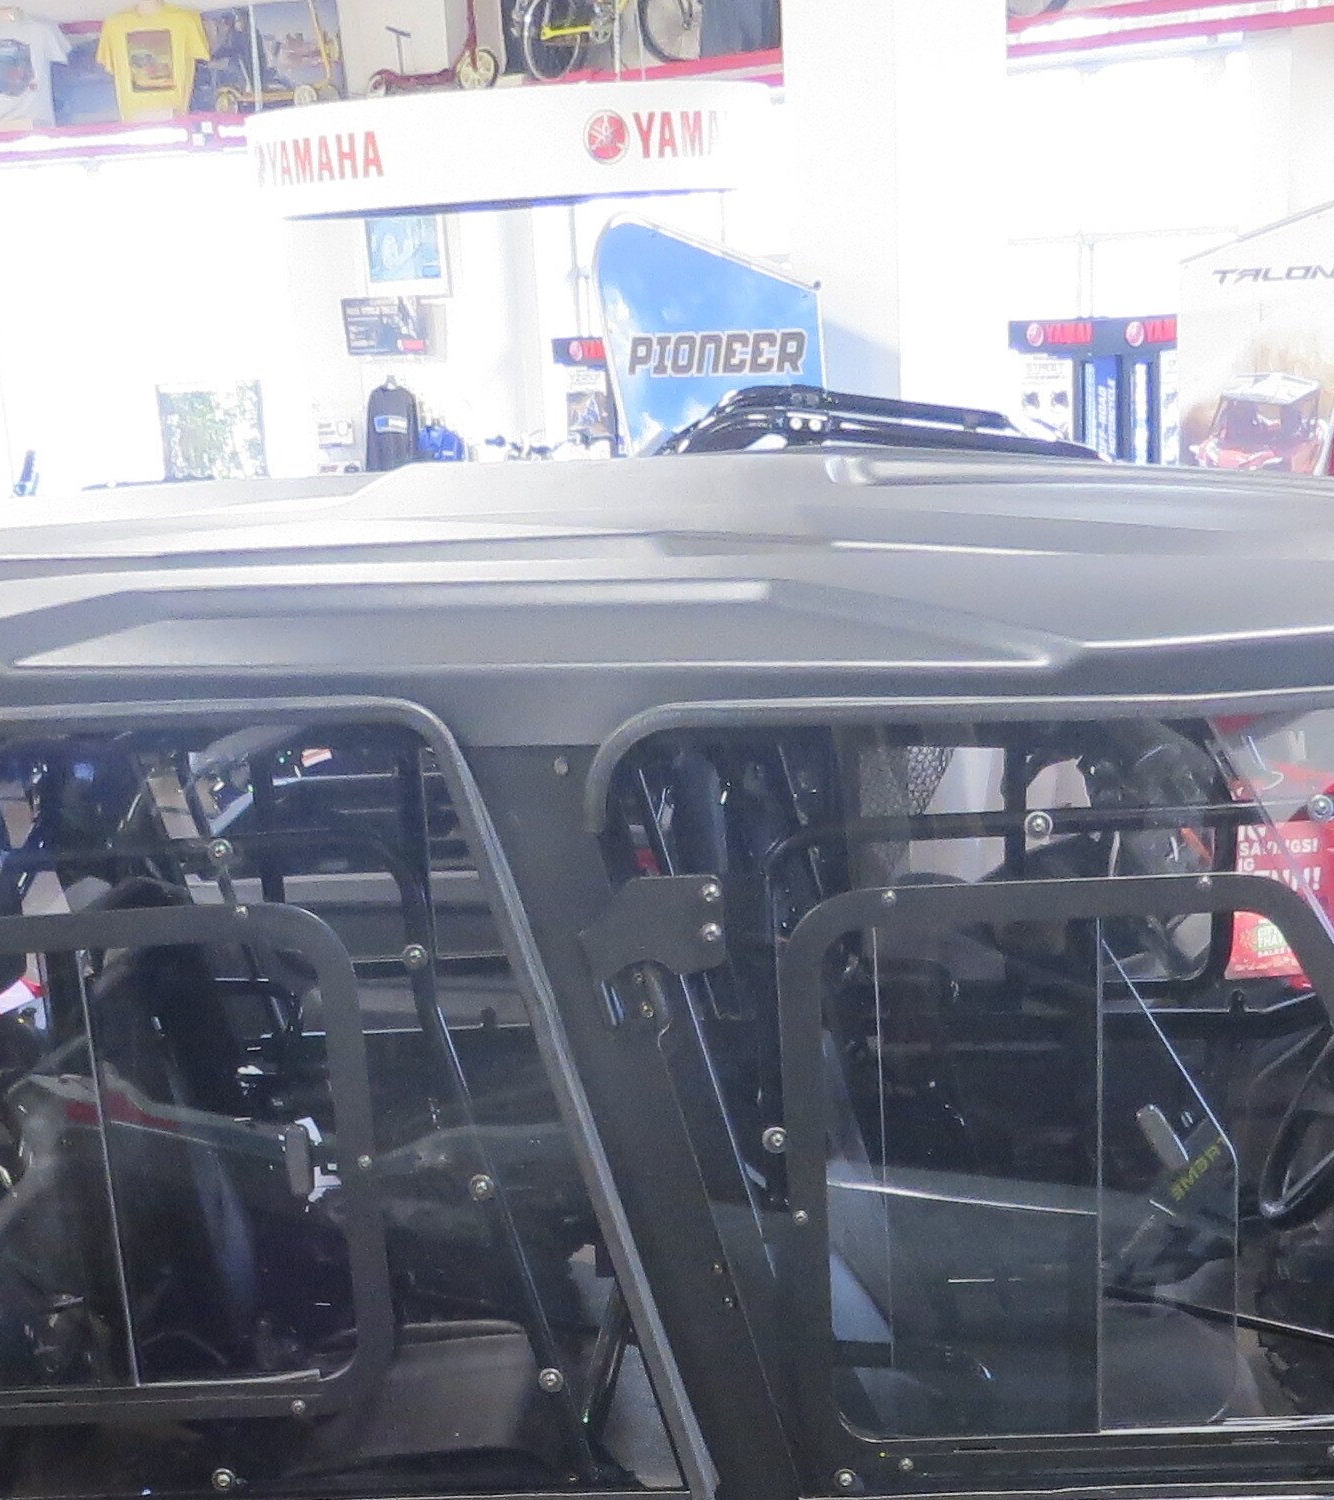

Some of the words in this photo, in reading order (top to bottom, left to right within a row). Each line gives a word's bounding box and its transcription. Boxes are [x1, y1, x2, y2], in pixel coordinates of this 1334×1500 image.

[266, 131, 384, 187] YAMAHA
[627, 329, 807, 377] PIONEER
[1239, 837, 1319, 855] SAGS!
